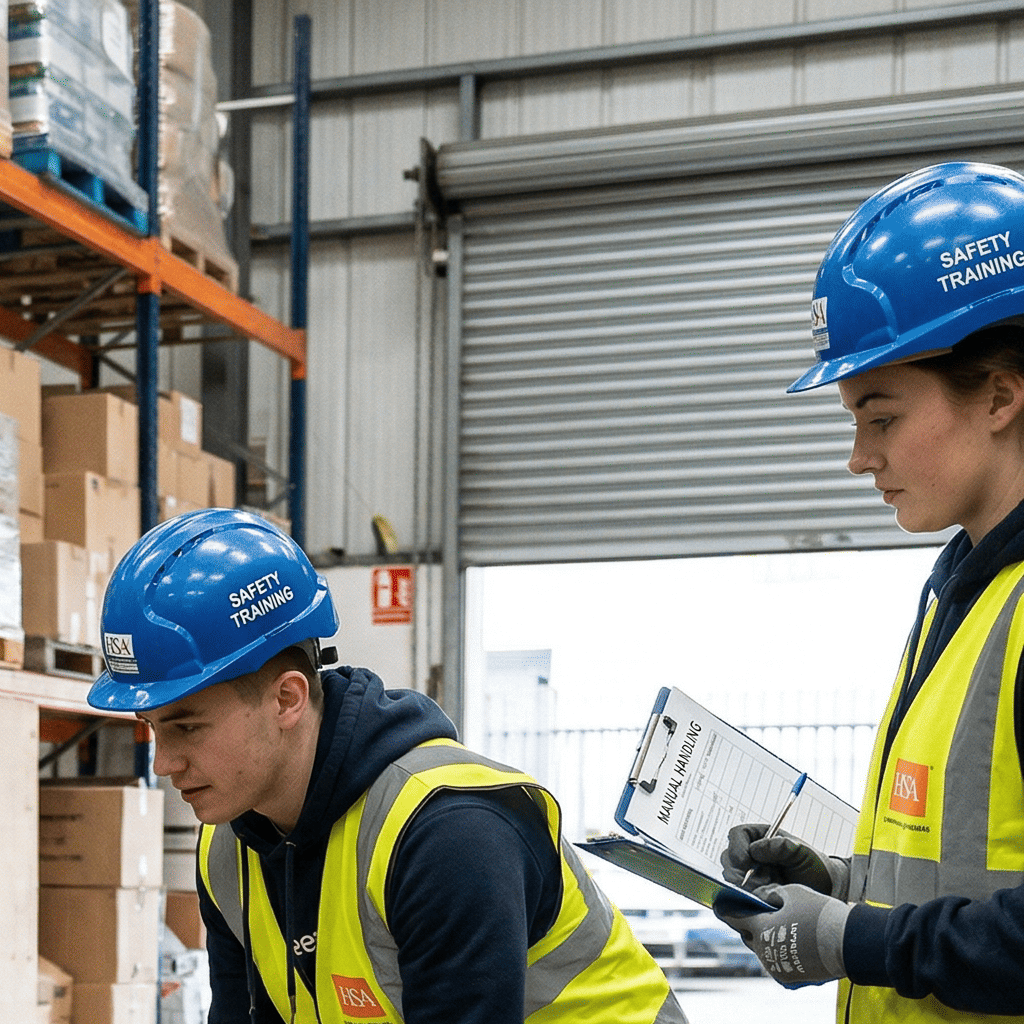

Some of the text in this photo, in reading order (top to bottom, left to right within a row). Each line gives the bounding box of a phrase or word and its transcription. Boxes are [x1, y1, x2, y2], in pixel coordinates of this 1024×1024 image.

[939, 231, 1011, 269] SAFETY
[937, 250, 1024, 293] TRAINING
[228, 570, 281, 608] SAFETY
[229, 586, 294, 628] TRAINING
[106, 636, 131, 655] HSA
[657, 778, 683, 825] MANUAL
[673, 720, 702, 777] HANDLING
[894, 771, 919, 802] HSA
[338, 985, 377, 1008] HSA
